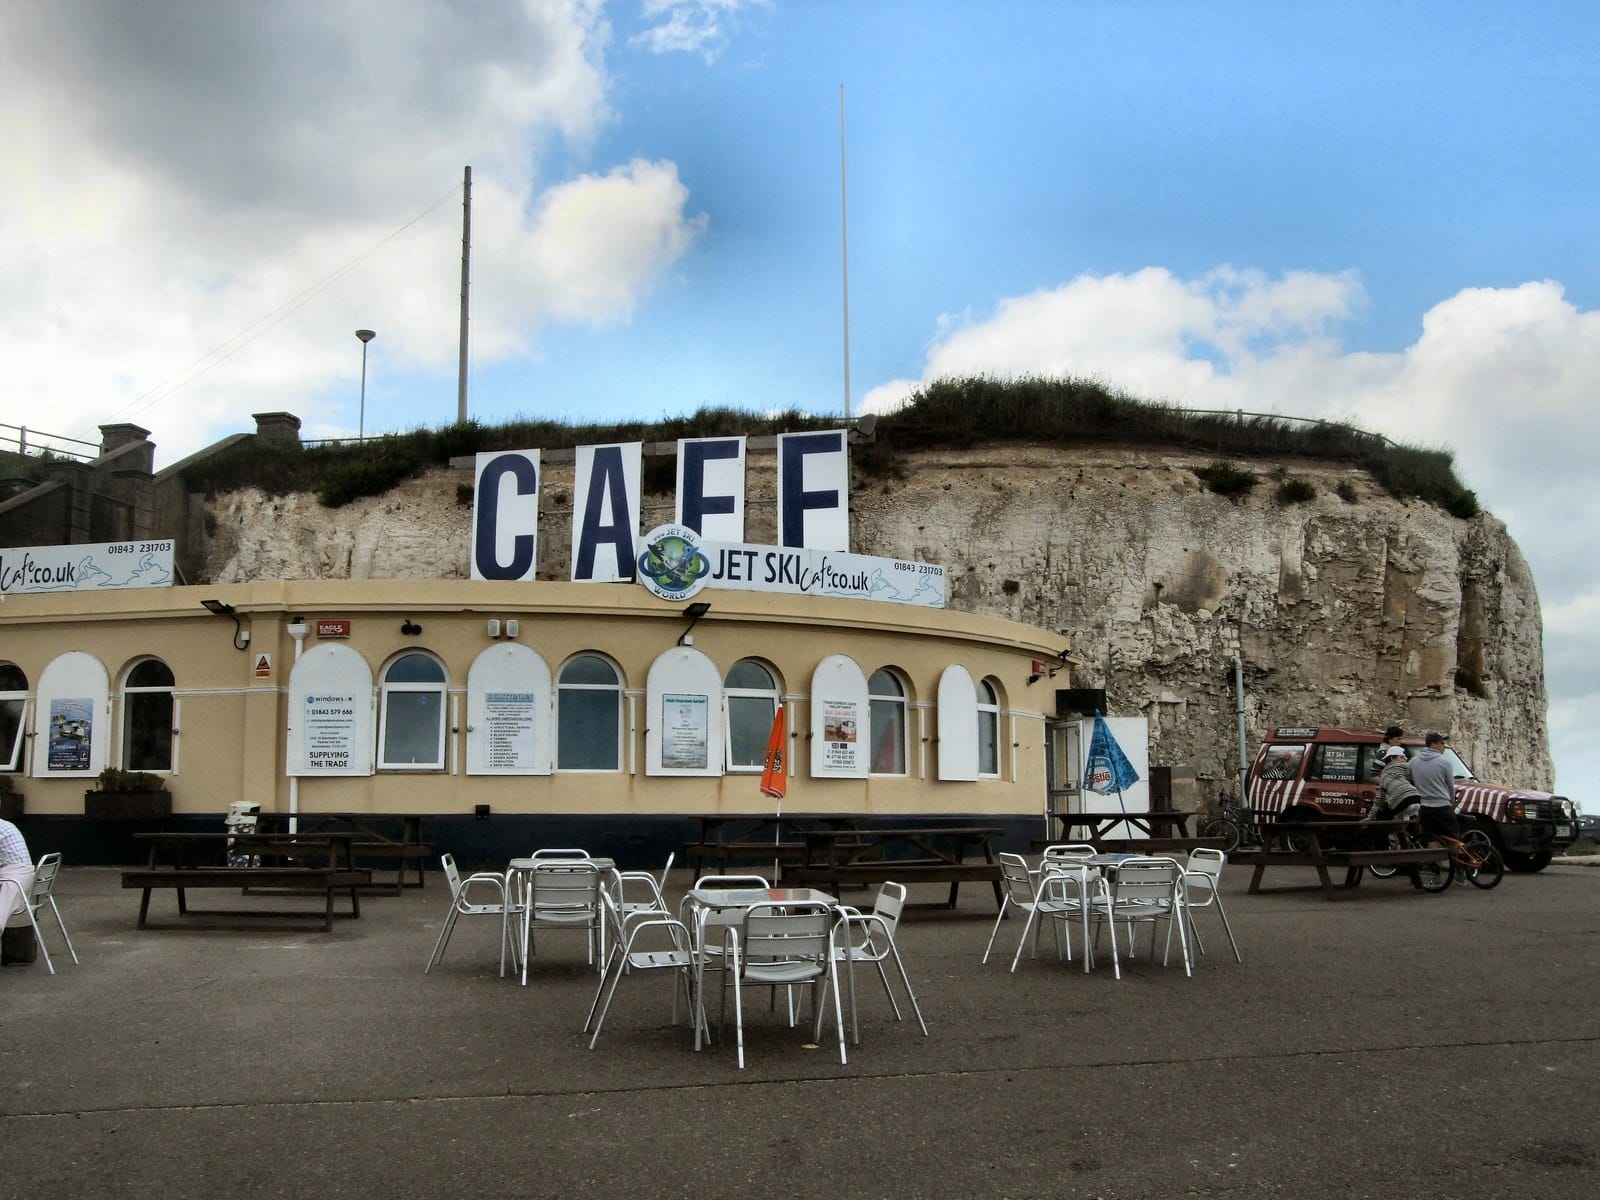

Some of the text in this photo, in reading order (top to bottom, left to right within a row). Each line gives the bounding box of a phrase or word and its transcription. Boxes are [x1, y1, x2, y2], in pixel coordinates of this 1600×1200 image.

[108, 543, 171, 555] 01843 231703
[713, 549, 759, 581] JET
[894, 562, 944, 578] 01843 231703
[309, 751, 349, 759] SUPPLYING
[310, 760, 348, 768] THE TRADE
